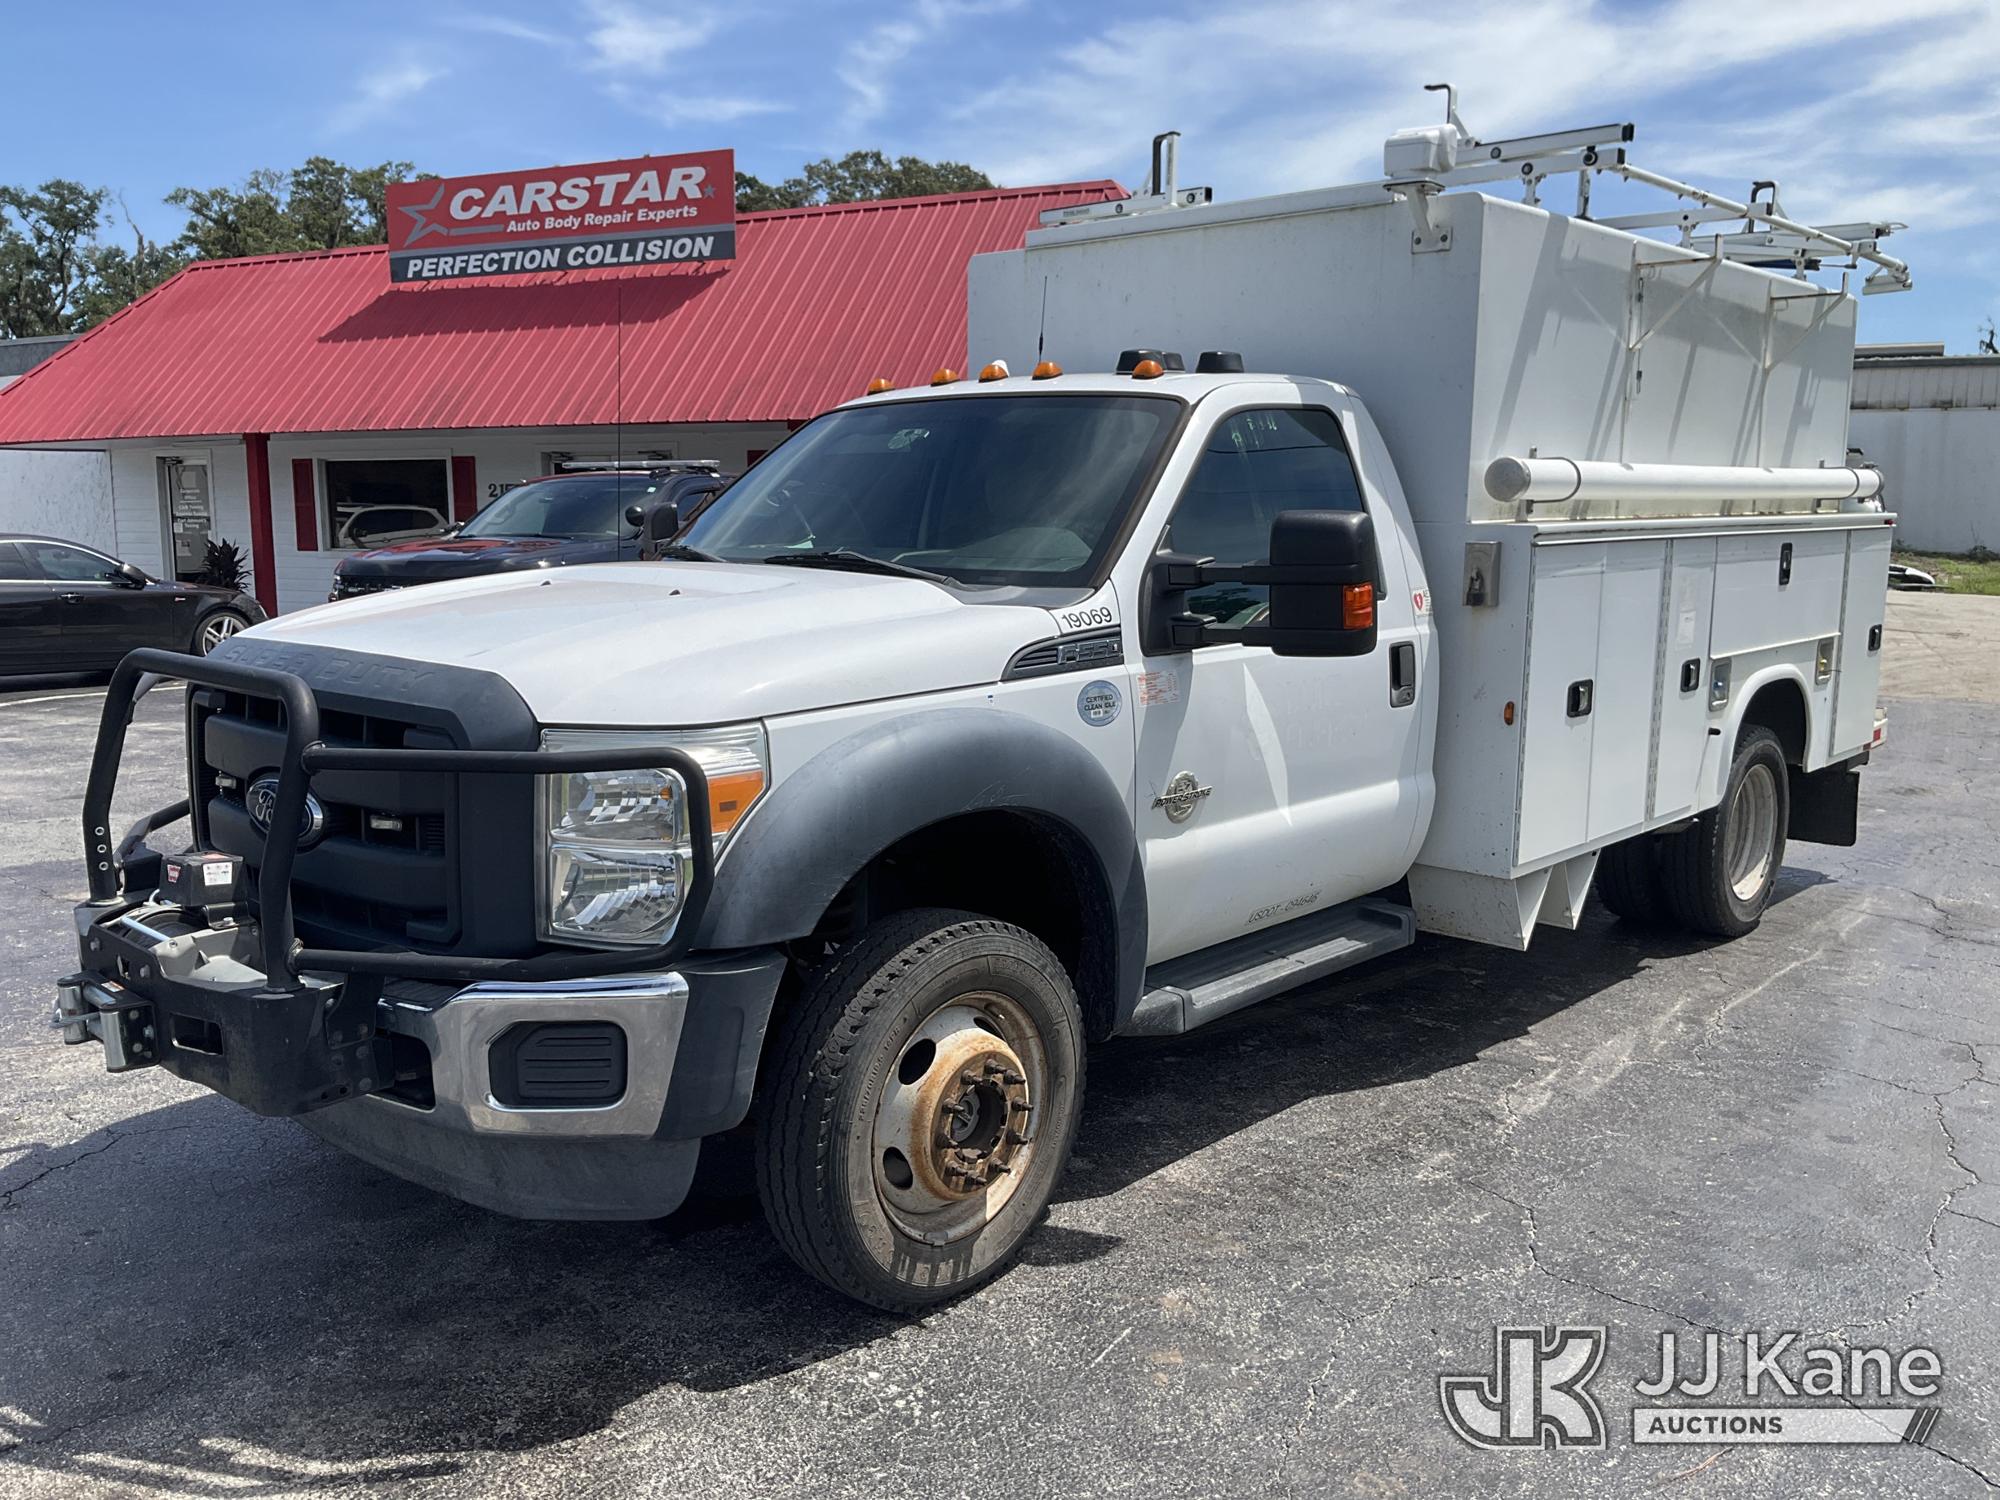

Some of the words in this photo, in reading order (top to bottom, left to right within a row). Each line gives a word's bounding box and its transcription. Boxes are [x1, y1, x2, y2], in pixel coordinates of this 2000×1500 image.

[450, 166, 706, 221] CARSTAR
[507, 219, 540, 233] Auto
[544, 215, 581, 231] Body
[584, 211, 633, 227] Repair
[637, 206, 697, 223] Experts
[407, 248, 560, 279] PERFECTION
[567, 236, 714, 265] COLLISION
[1061, 606, 1113, 629] 19069
[224, 645, 313, 676] SUPER
[316, 656, 434, 692] DUTY
[1083, 703, 1103, 711] CLEAN
[1085, 694, 1114, 704] CERTIFIED
